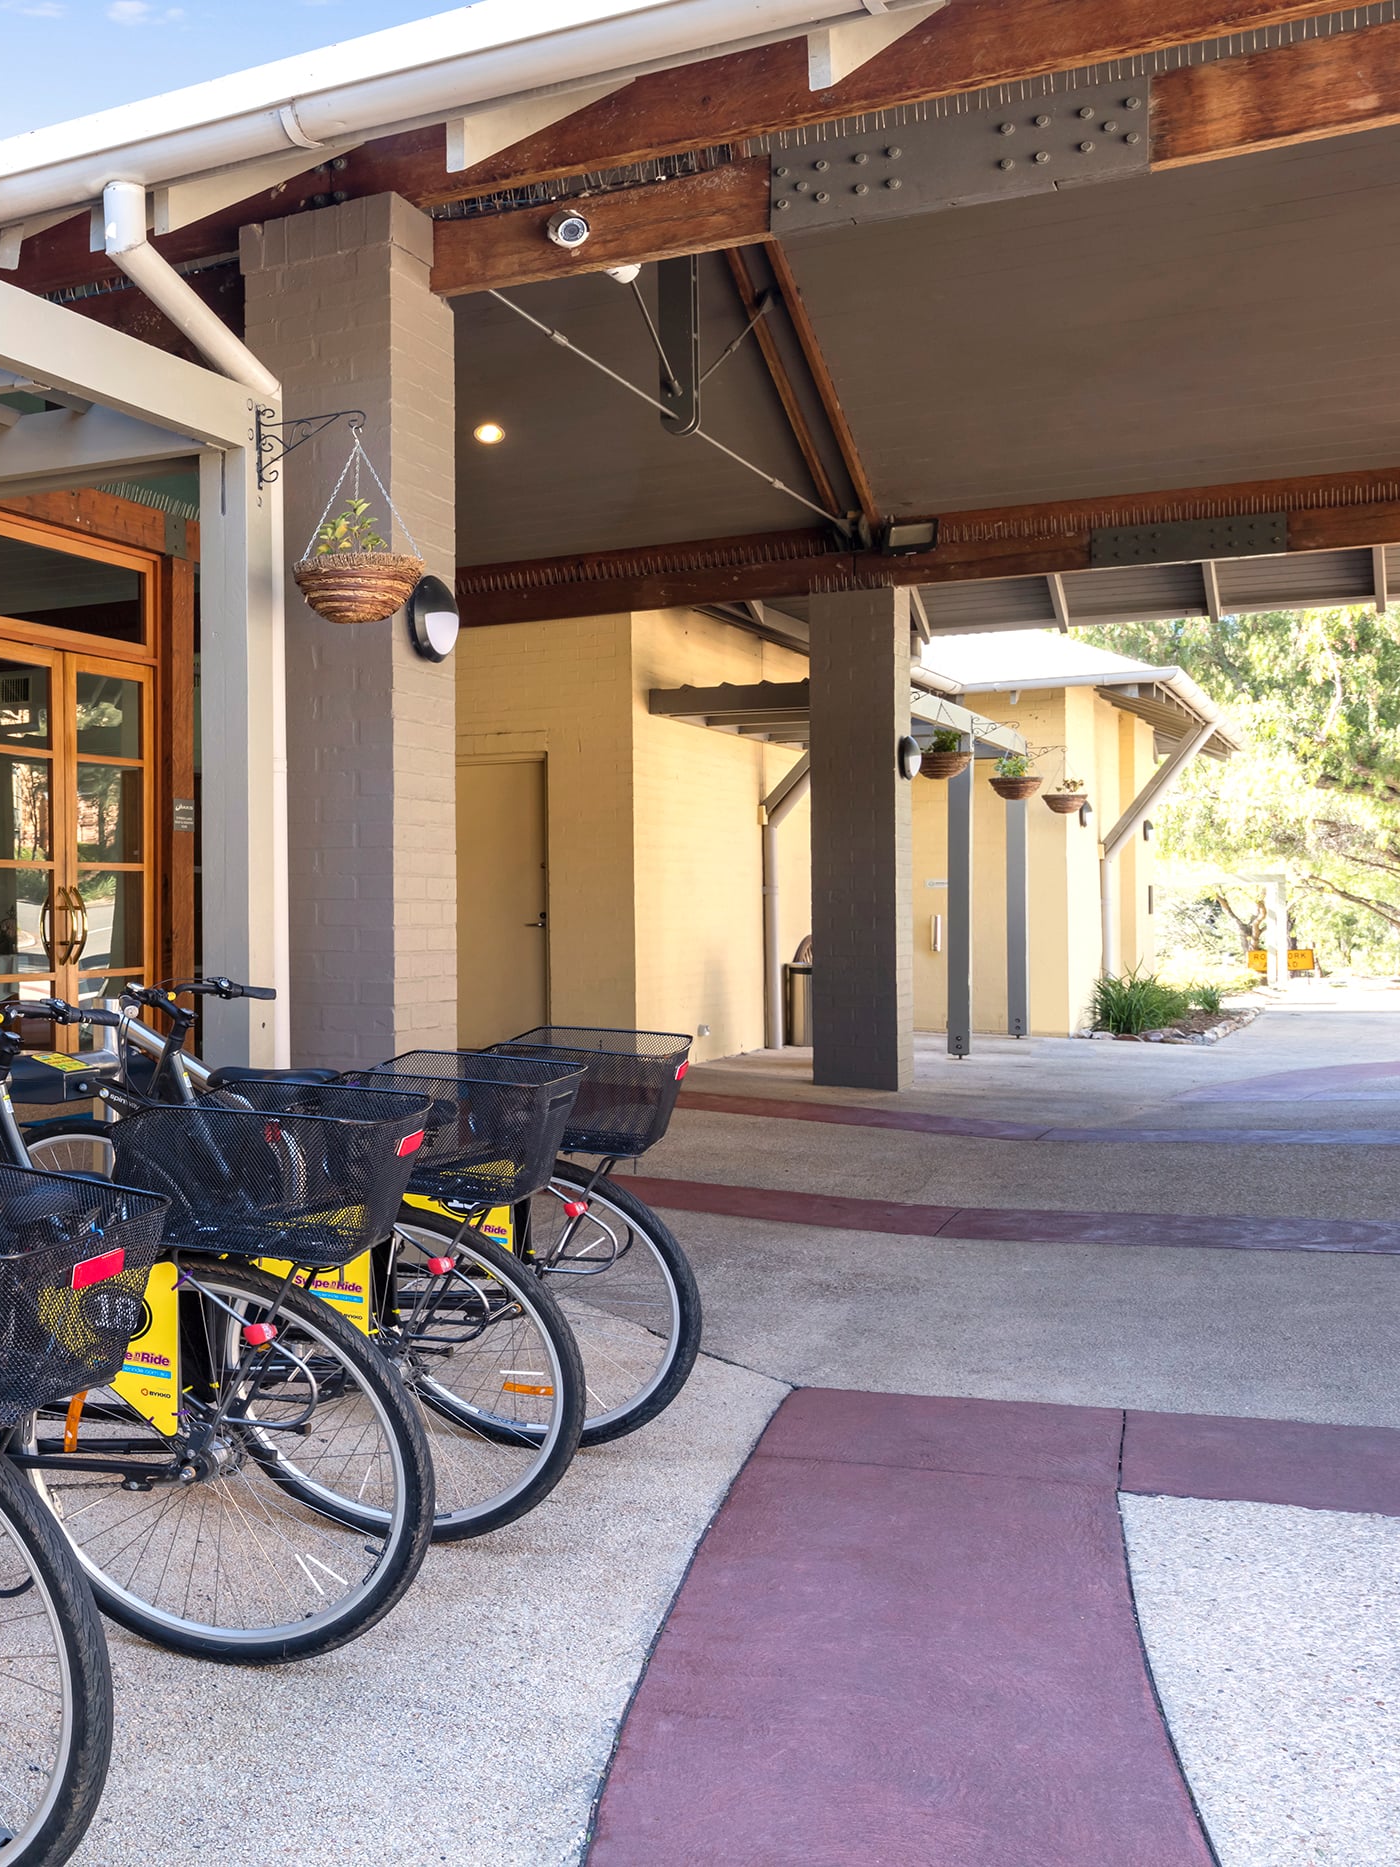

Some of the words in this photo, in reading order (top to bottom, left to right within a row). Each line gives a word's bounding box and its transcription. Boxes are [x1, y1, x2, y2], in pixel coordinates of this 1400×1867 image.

[484, 1225, 506, 1235] Ride
[337, 1280, 362, 1292] Ride
[141, 1353, 170, 1366] Ride
